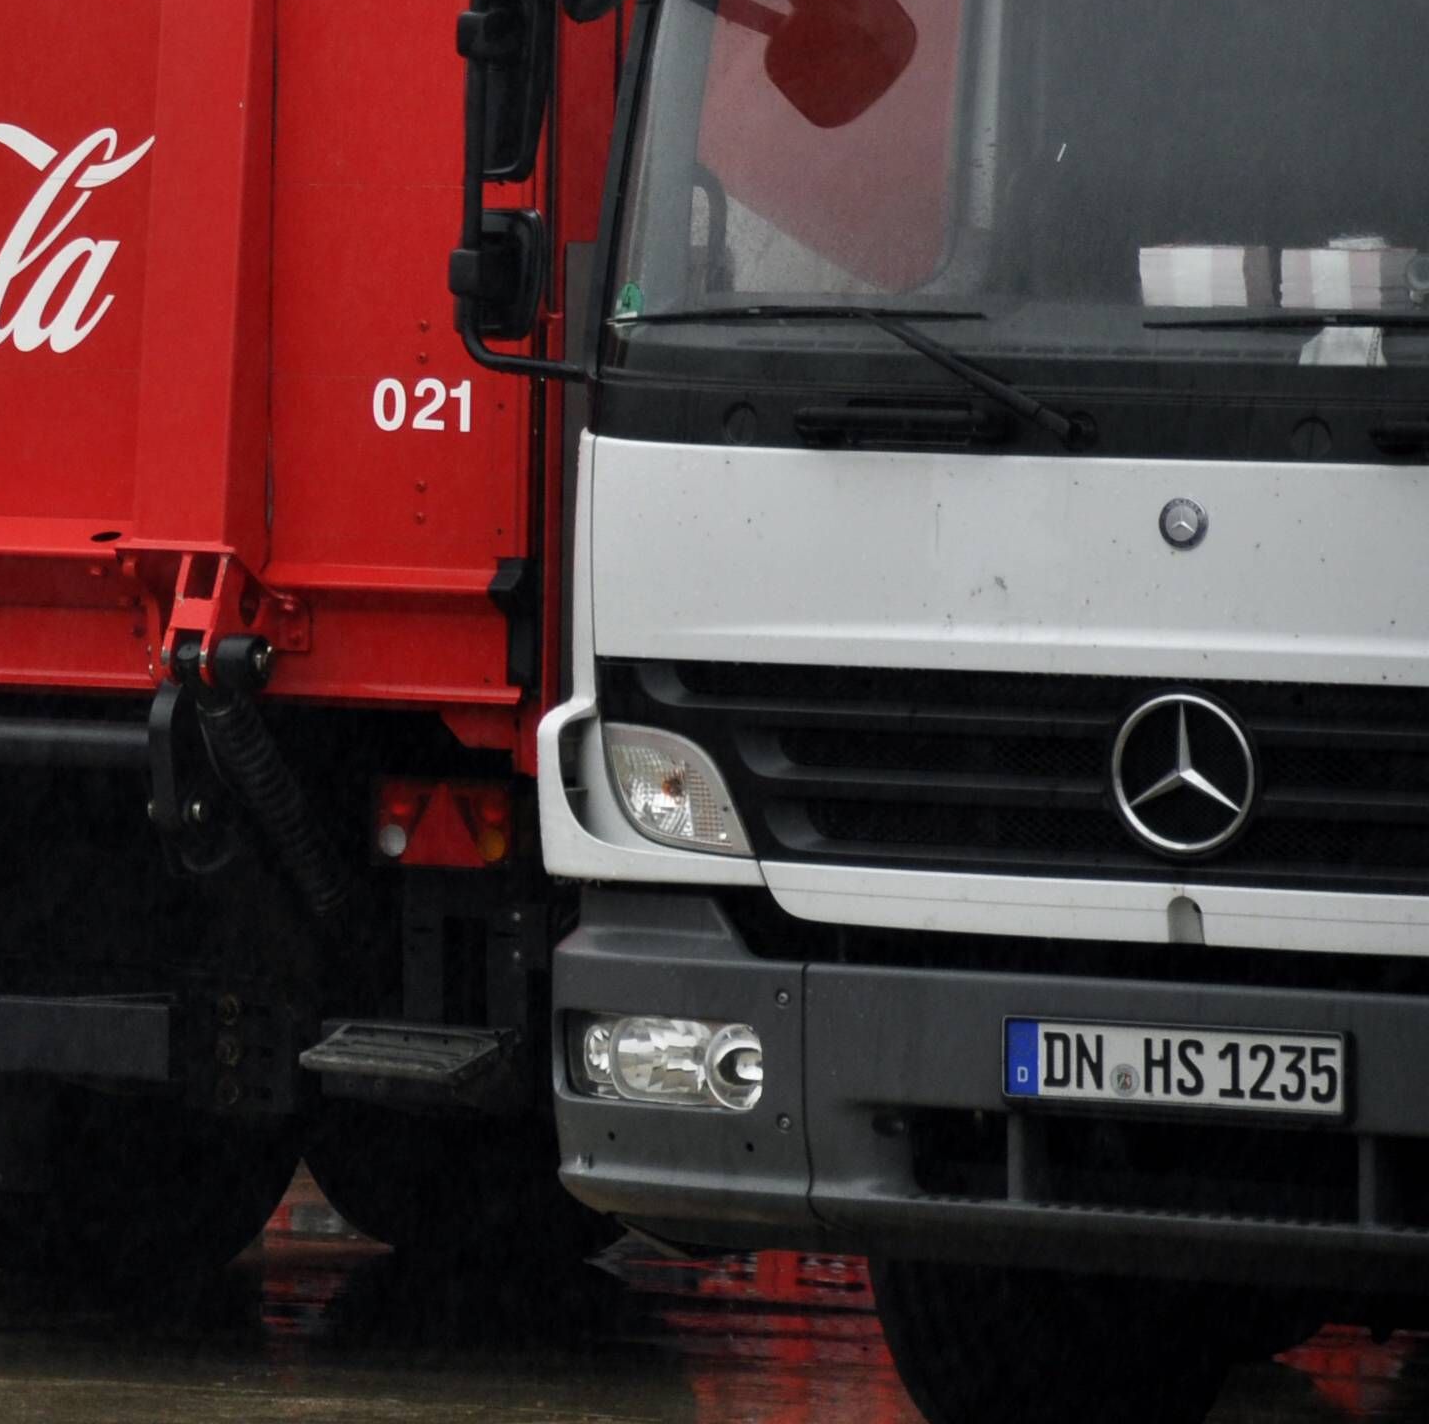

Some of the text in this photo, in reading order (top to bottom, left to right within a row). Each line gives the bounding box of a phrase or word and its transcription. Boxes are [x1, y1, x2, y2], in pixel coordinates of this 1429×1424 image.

[372, 377, 472, 433] 021
[1017, 1031, 1339, 1104] D DN HS 1235
